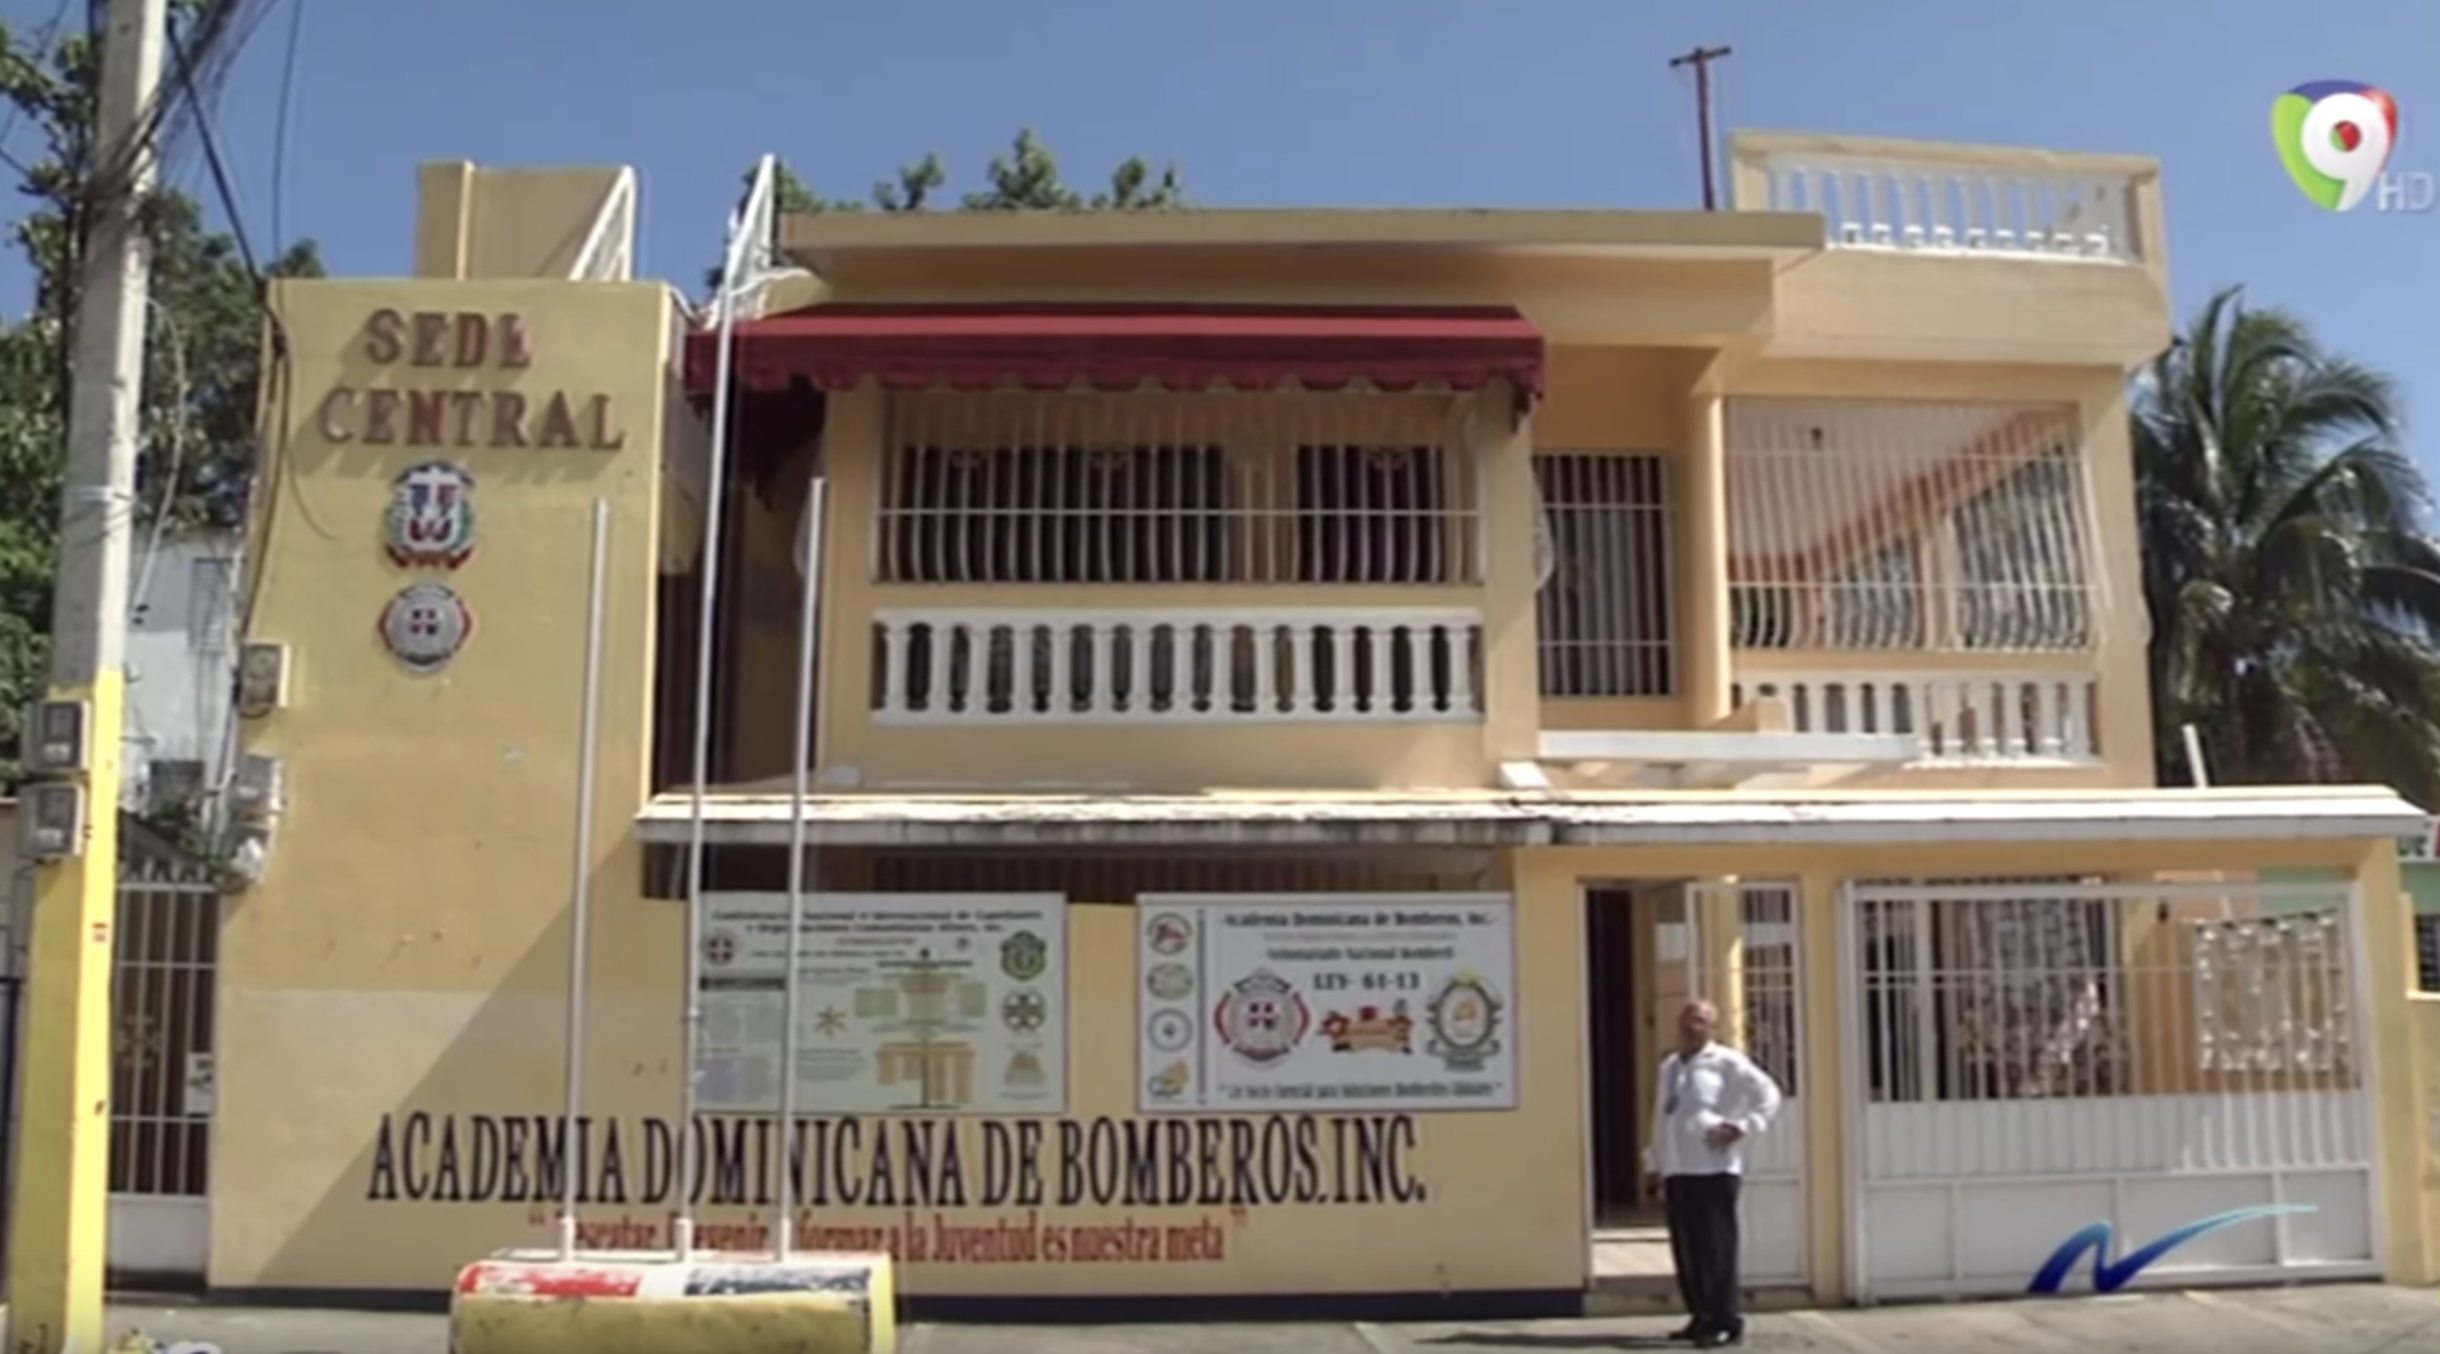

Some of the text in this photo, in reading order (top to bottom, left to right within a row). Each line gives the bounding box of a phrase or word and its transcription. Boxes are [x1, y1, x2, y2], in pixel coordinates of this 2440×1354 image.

[364, 307, 533, 370] SEDE
[318, 386, 626, 452] CENTRAL
[367, 1111, 628, 1201] ACADEMIA
[641, 1114, 966, 1206] DOMINICANA
[982, 1117, 1043, 1206] DE
[1071, 1217, 1160, 1261] nuestra
